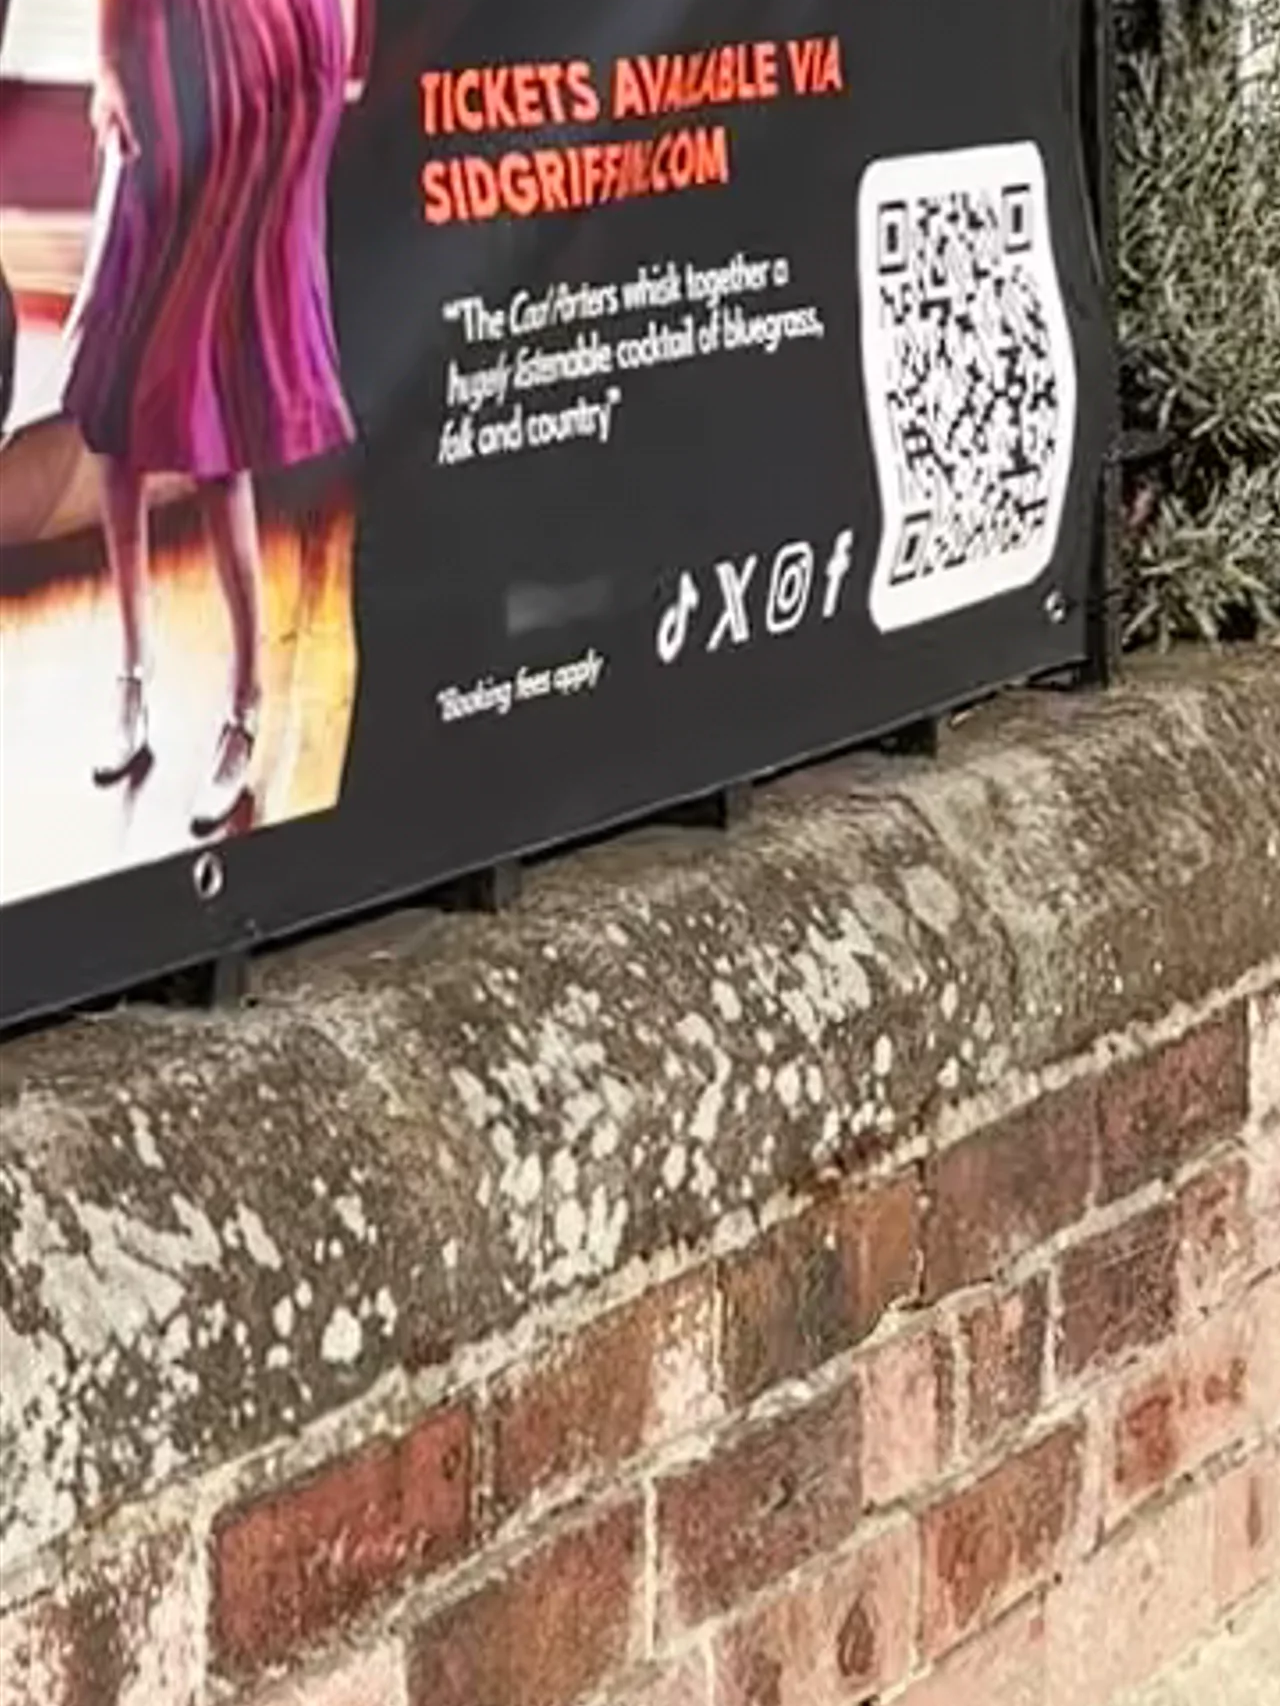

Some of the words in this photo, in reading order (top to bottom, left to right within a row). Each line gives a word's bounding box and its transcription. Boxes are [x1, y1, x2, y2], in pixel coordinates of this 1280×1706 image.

[420, 60, 600, 136] TICKETS
[612, 42, 779, 120] AVAILABLE
[787, 35, 843, 94] VIA
[620, 260, 683, 311] whisk
[684, 251, 771, 309] together
[772, 257, 790, 287] a
[616, 313, 696, 369] cocktail
[698, 308, 720, 356] of
[722, 304, 825, 355] bluegrass,
[476, 402, 524, 456] and
[515, 664, 551, 702] fees
[552, 646, 605, 696] apply
